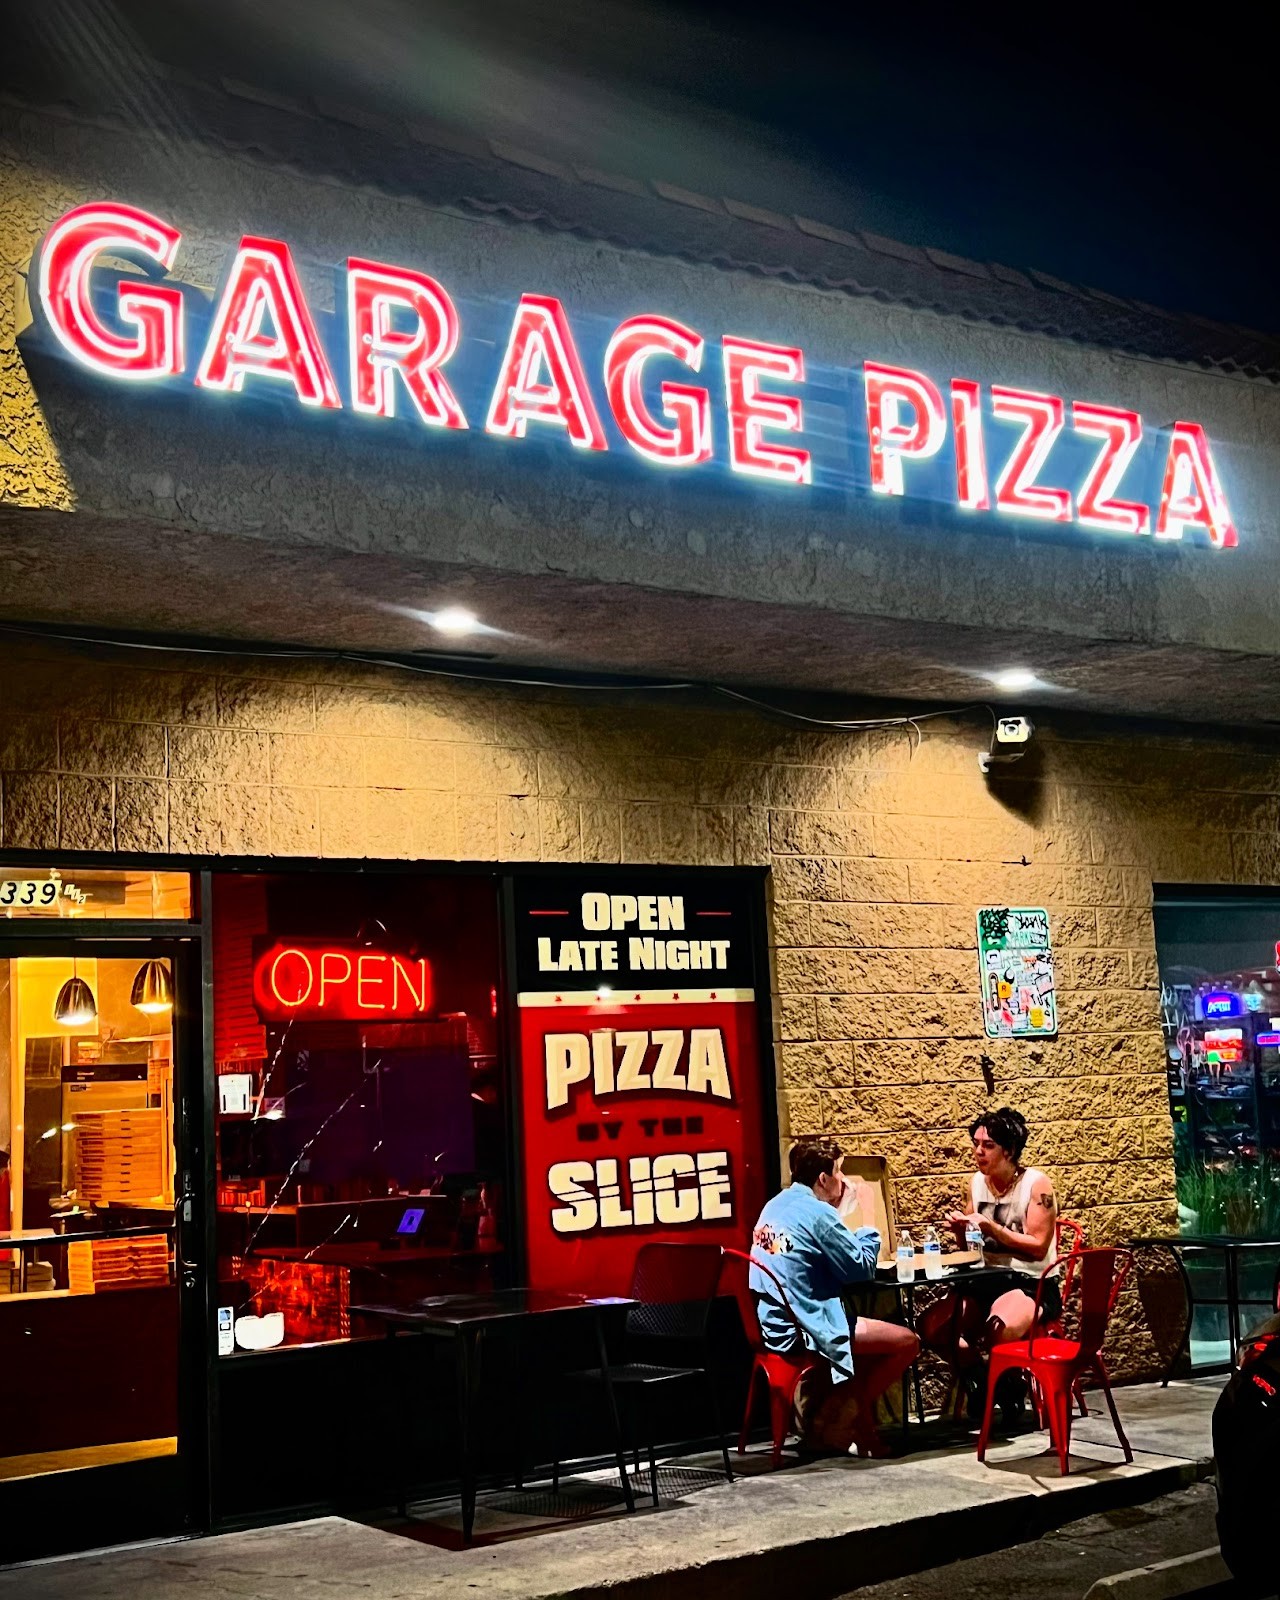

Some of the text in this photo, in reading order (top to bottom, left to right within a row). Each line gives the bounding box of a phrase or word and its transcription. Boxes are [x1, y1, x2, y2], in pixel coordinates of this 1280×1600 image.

[38, 200, 1239, 549] GARAGE PIZZA
[581, 892, 686, 931] OPEN
[271, 949, 426, 1012] OPEN
[538, 937, 731, 972] LATE NIGHT
[544, 1028, 732, 1111] PIZZA
[548, 1151, 732, 1233] SLICE
